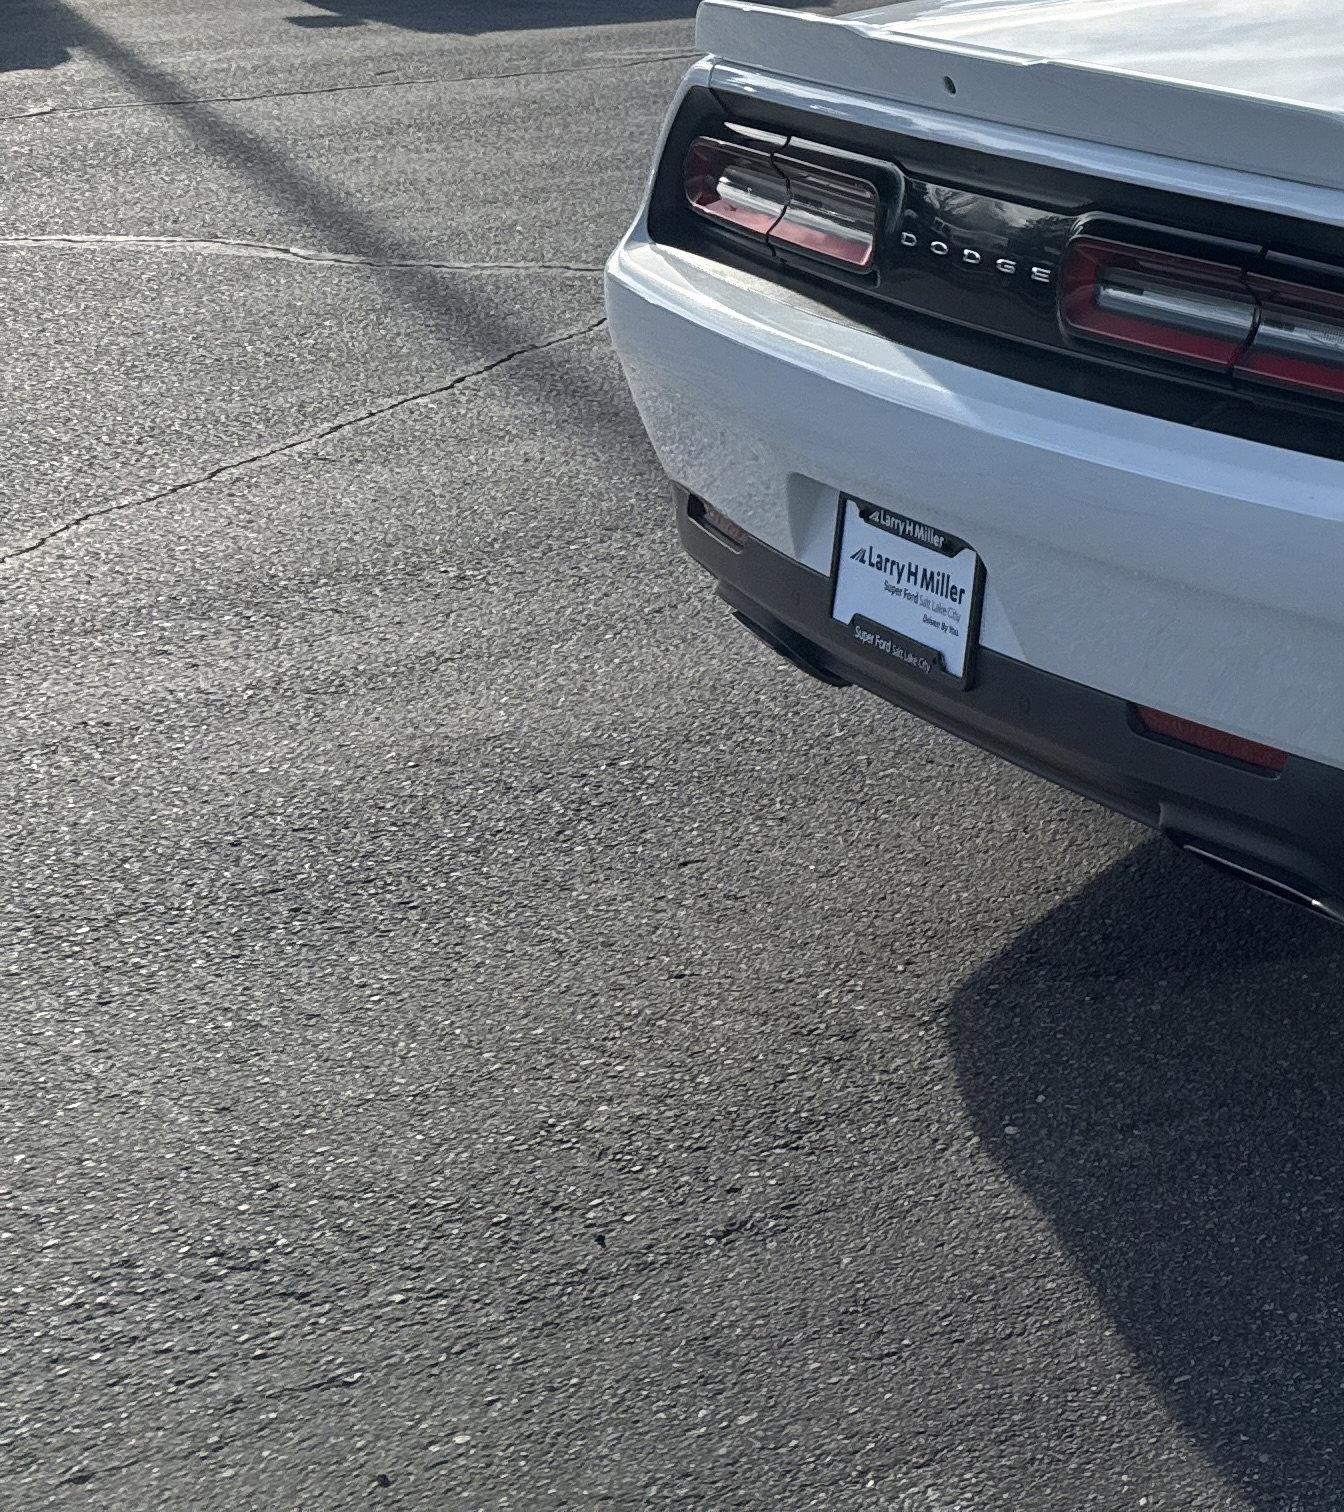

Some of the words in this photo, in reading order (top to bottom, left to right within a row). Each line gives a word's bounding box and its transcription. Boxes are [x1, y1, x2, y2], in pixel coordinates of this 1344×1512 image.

[901, 232, 1051, 283] DODGE
[880, 509, 905, 535] Larry
[906, 520, 914, 536] H
[914, 524, 944, 548] Miller
[868, 545, 905, 584] Larry
[906, 561, 919, 586] H
[920, 567, 966, 605] Miller
[884, 580, 902, 596] Super
[903, 588, 919, 604] Ford
[931, 600, 947, 616] Lake
[854, 625, 875, 644] Super
[875, 634, 891, 653] Ford
[904, 649, 918, 666] Lake
[918, 657, 931, 674] City
